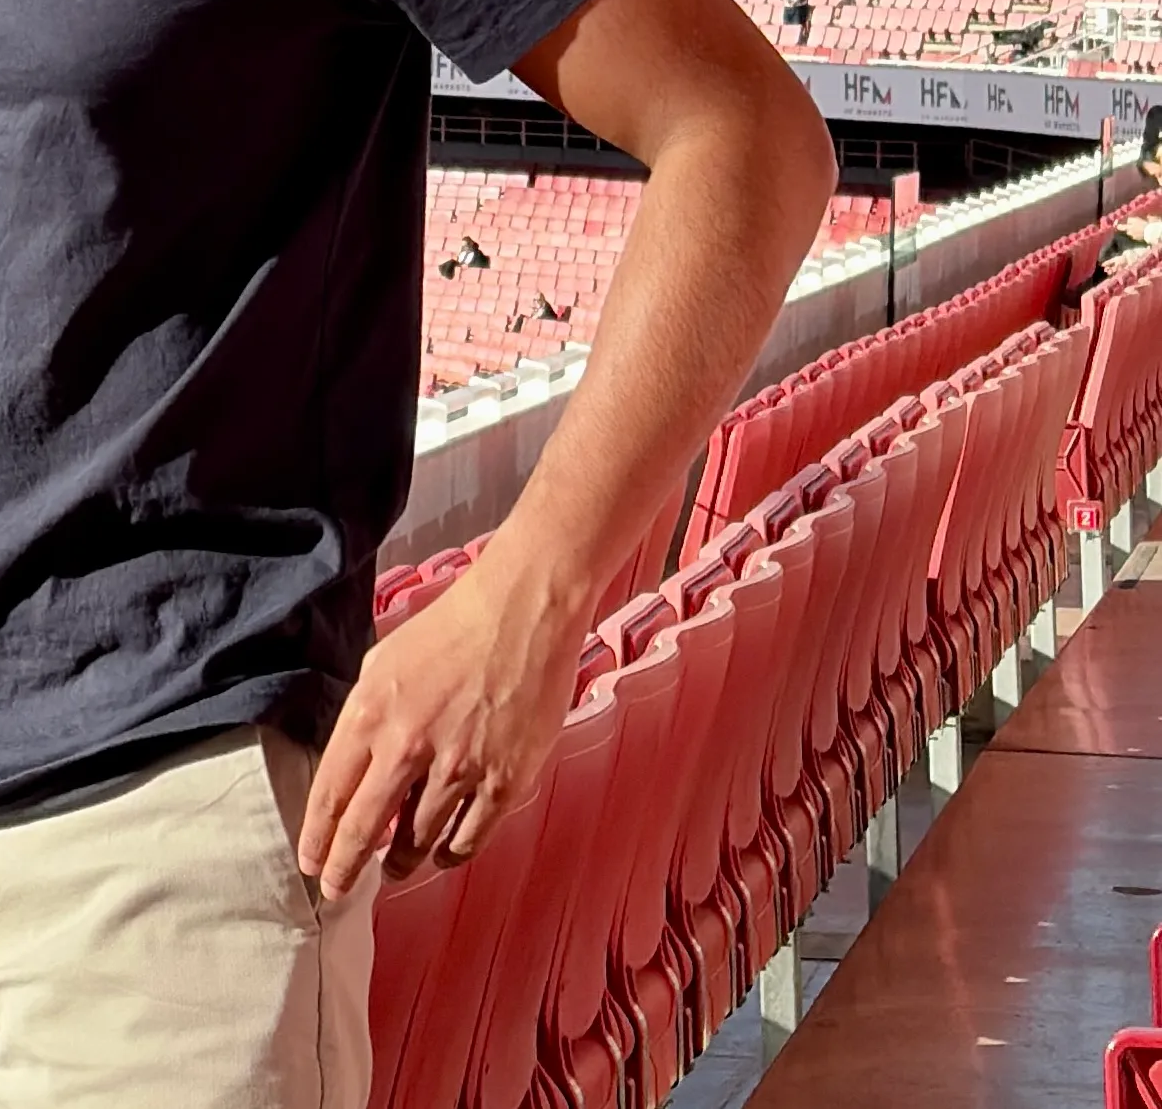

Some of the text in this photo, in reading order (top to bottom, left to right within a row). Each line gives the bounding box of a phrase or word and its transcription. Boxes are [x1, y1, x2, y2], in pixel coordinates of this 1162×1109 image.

[844, 73, 891, 105] HFM
[1045, 83, 1080, 120] HFM
[1112, 88, 1149, 122] HFM
[1081, 511, 1091, 526] 2
